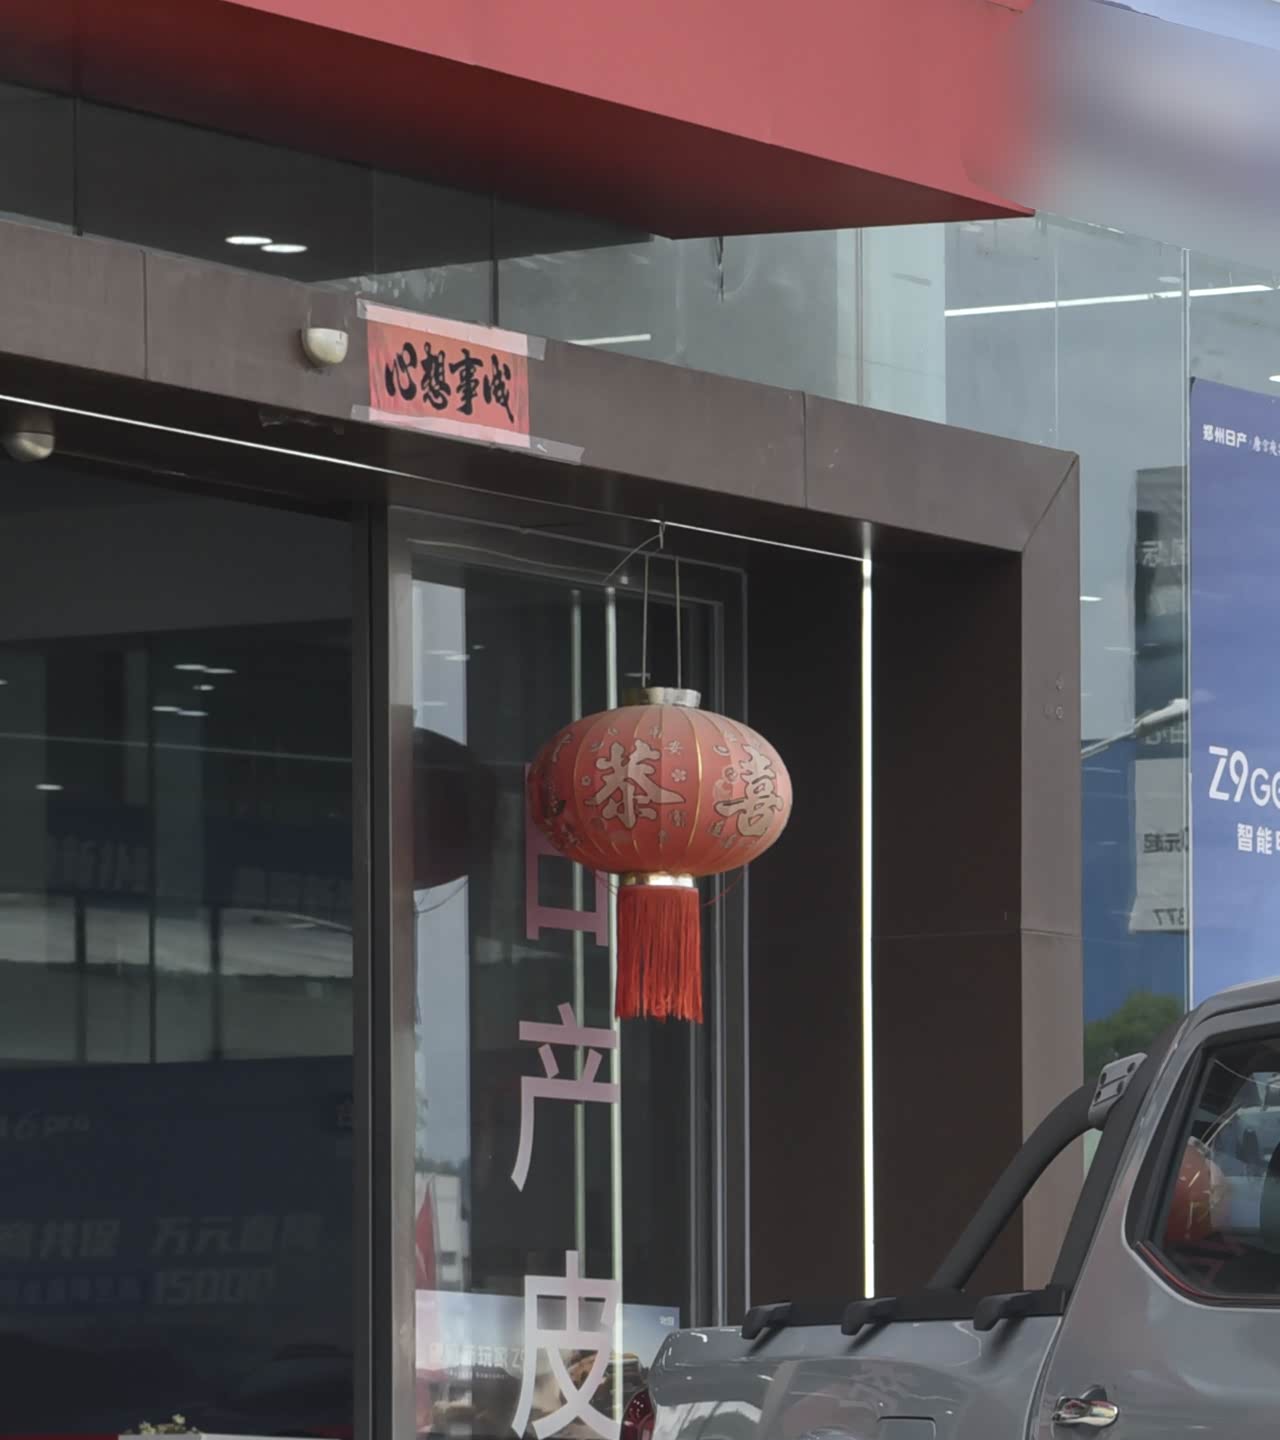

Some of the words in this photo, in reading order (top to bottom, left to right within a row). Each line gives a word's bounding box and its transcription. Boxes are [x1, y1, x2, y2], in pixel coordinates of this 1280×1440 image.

[385, 341, 515, 424] 心想事成
[1202, 424, 1247, 448] 郑州日产
